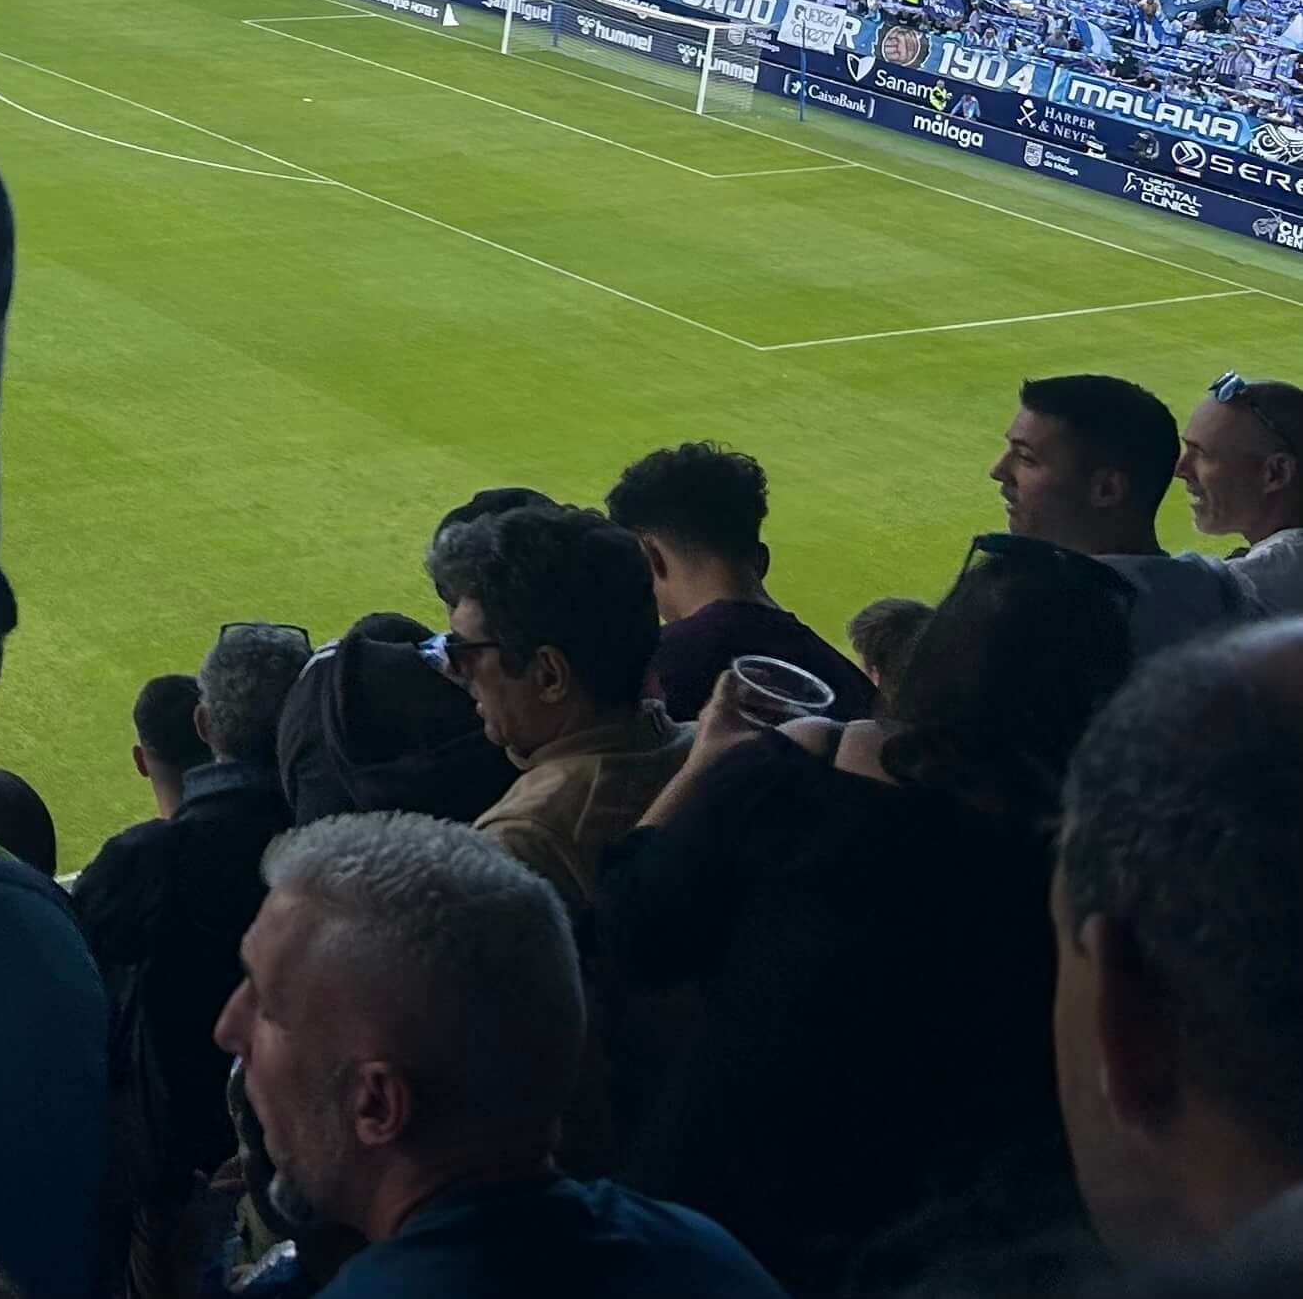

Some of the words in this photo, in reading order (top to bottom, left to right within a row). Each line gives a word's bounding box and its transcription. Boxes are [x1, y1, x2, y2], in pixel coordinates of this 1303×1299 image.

[595, 20, 652, 53] hummel
[938, 42, 1036, 95] 1904
[808, 84, 866, 114] CaixaBank
[1037, 121, 1050, 134] &
[1044, 106, 1096, 132] HARPER
[1141, 191, 1199, 218] CLINICS
[1143, 182, 1203, 208] DENTAL
